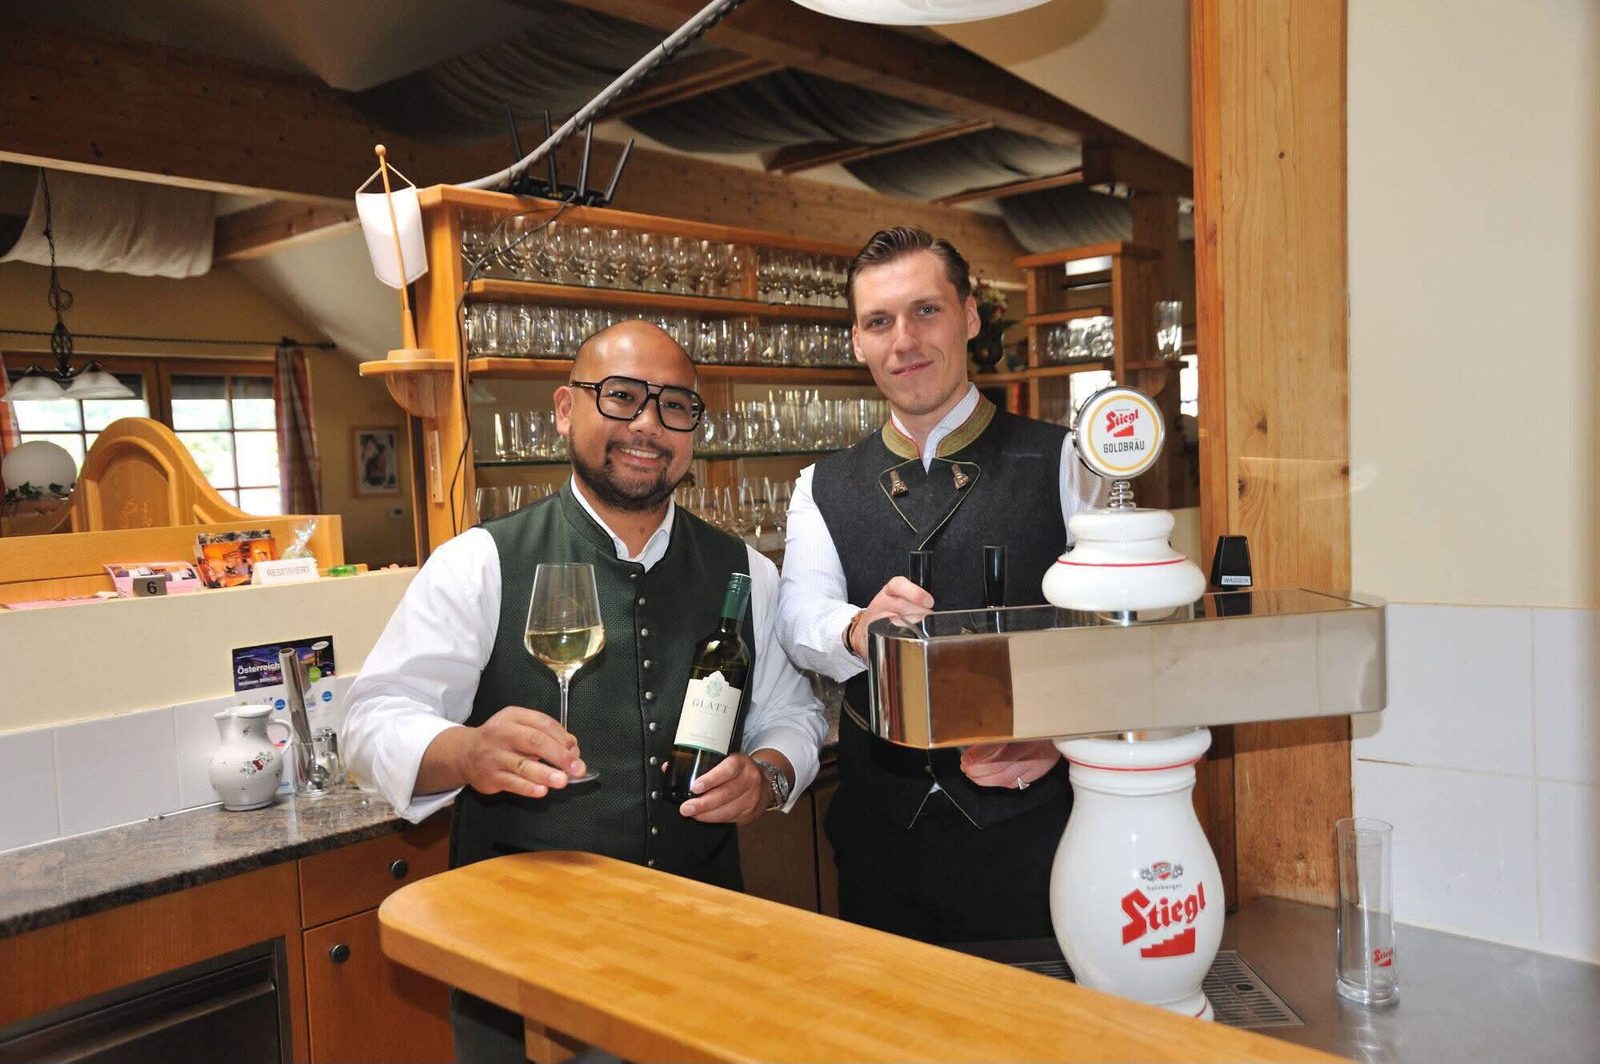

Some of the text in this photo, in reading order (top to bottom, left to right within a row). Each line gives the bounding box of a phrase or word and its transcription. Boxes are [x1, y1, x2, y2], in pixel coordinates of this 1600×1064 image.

[1106, 409, 1139, 433] Stiegl
[1103, 439, 1145, 453] GOLDBRÄU
[266, 566, 312, 577] RESERVIERT
[146, 581, 157, 595] 6
[692, 699, 730, 714] GLATT
[1121, 881, 1206, 945] Stiegl
